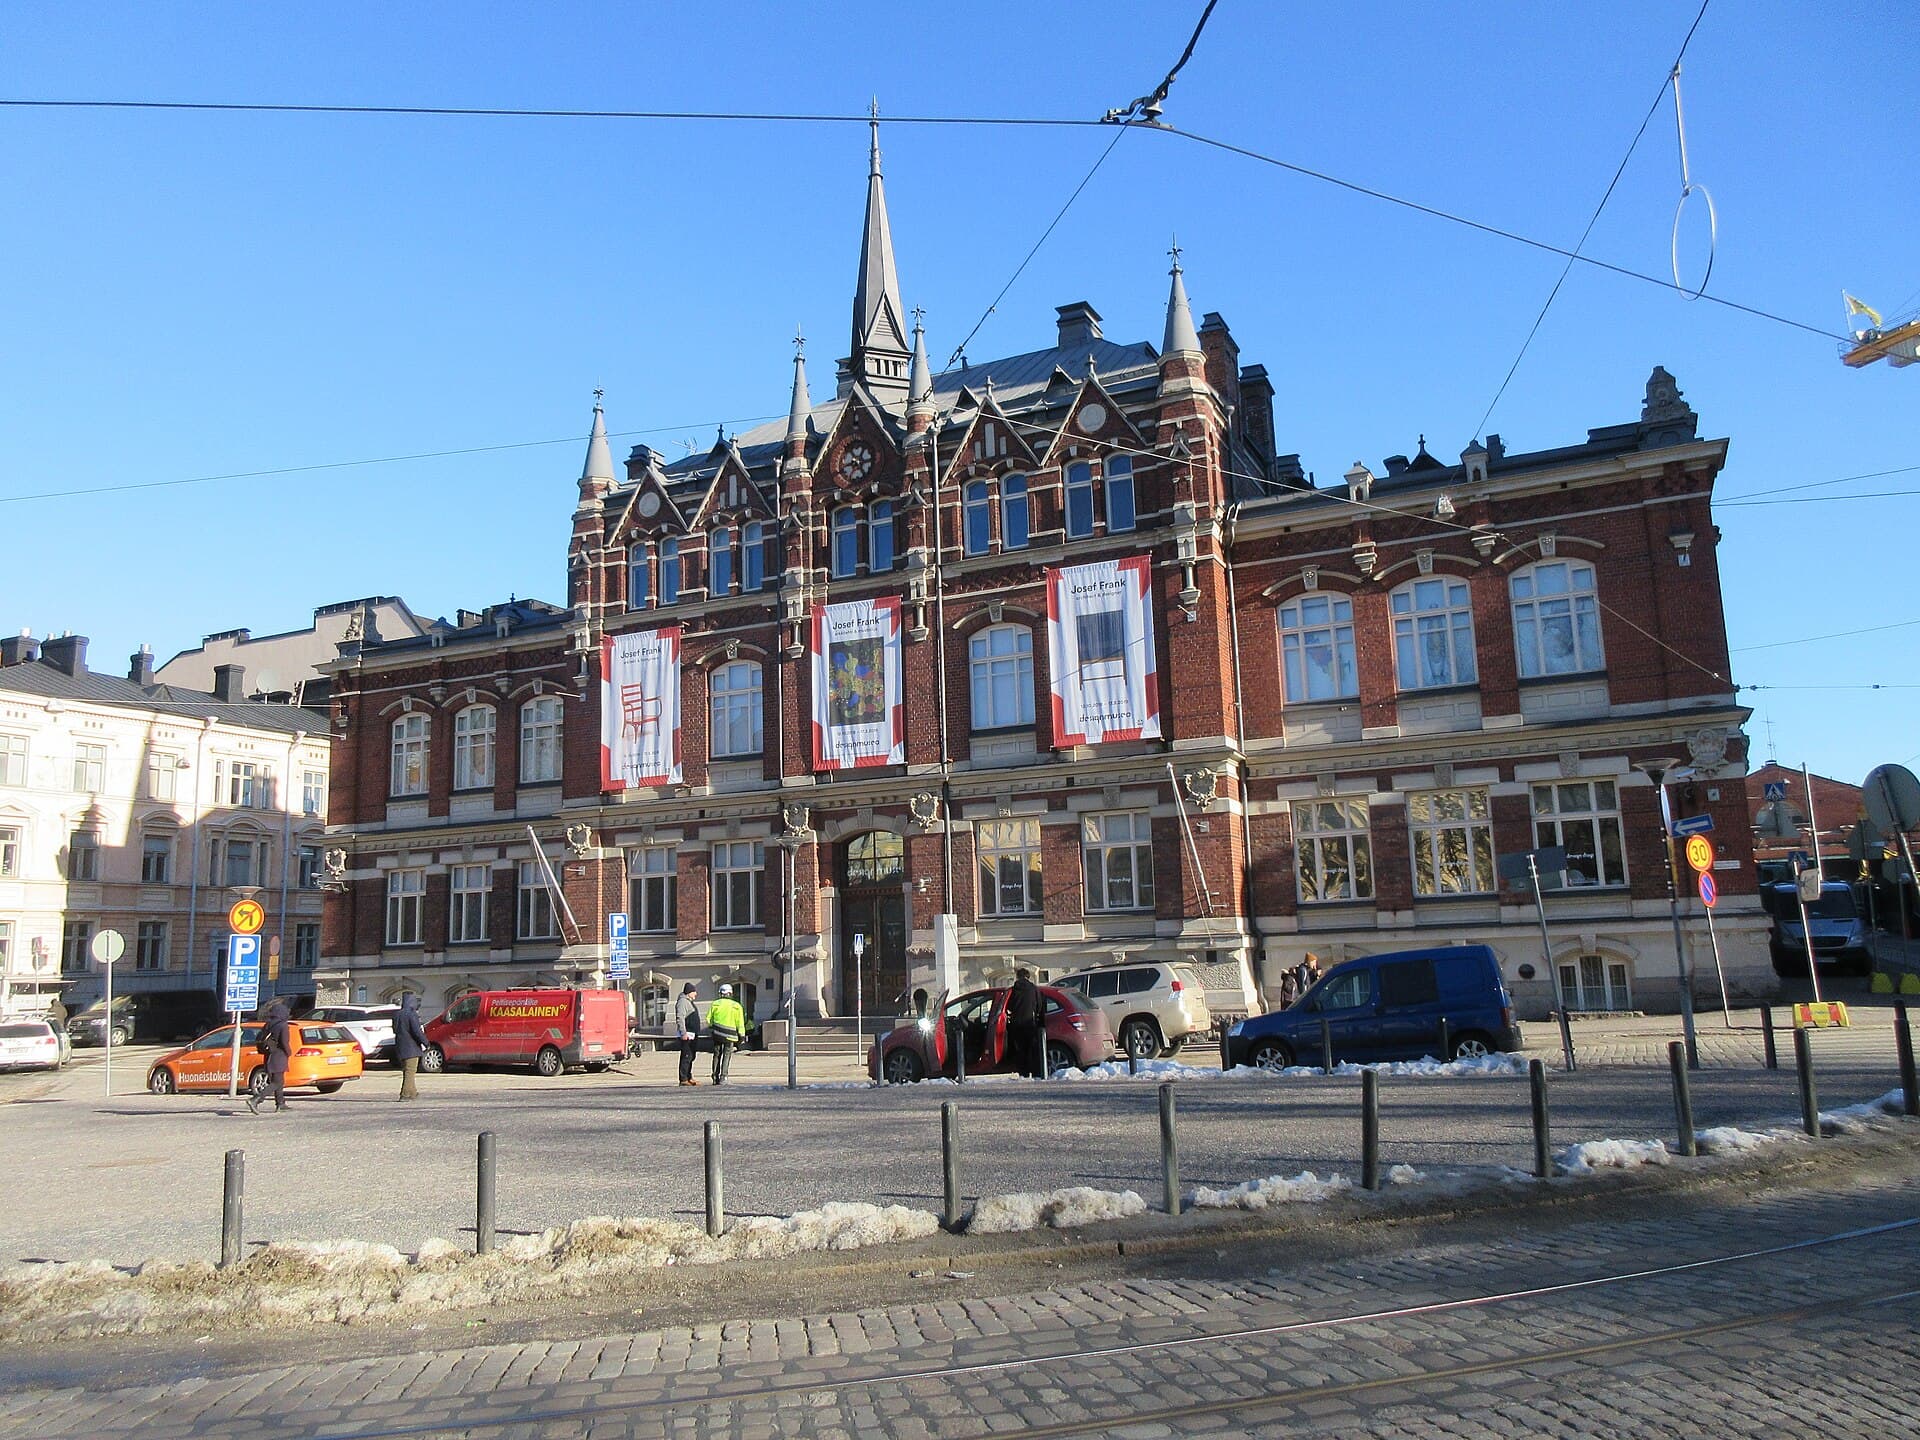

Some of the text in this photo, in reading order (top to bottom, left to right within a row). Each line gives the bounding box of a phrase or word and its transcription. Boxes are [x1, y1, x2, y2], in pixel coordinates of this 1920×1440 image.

[1071, 578, 1126, 594] Josef Frank
[833, 616, 880, 630] Josef Frank
[620, 646, 662, 659] Josef Frank
[1691, 844, 1707, 862] 30
[612, 915, 626, 937] P
[234, 937, 256, 965] P
[489, 1006, 560, 1017] KAASALAINEN
[178, 1070, 245, 1083] Huoneistokesus
